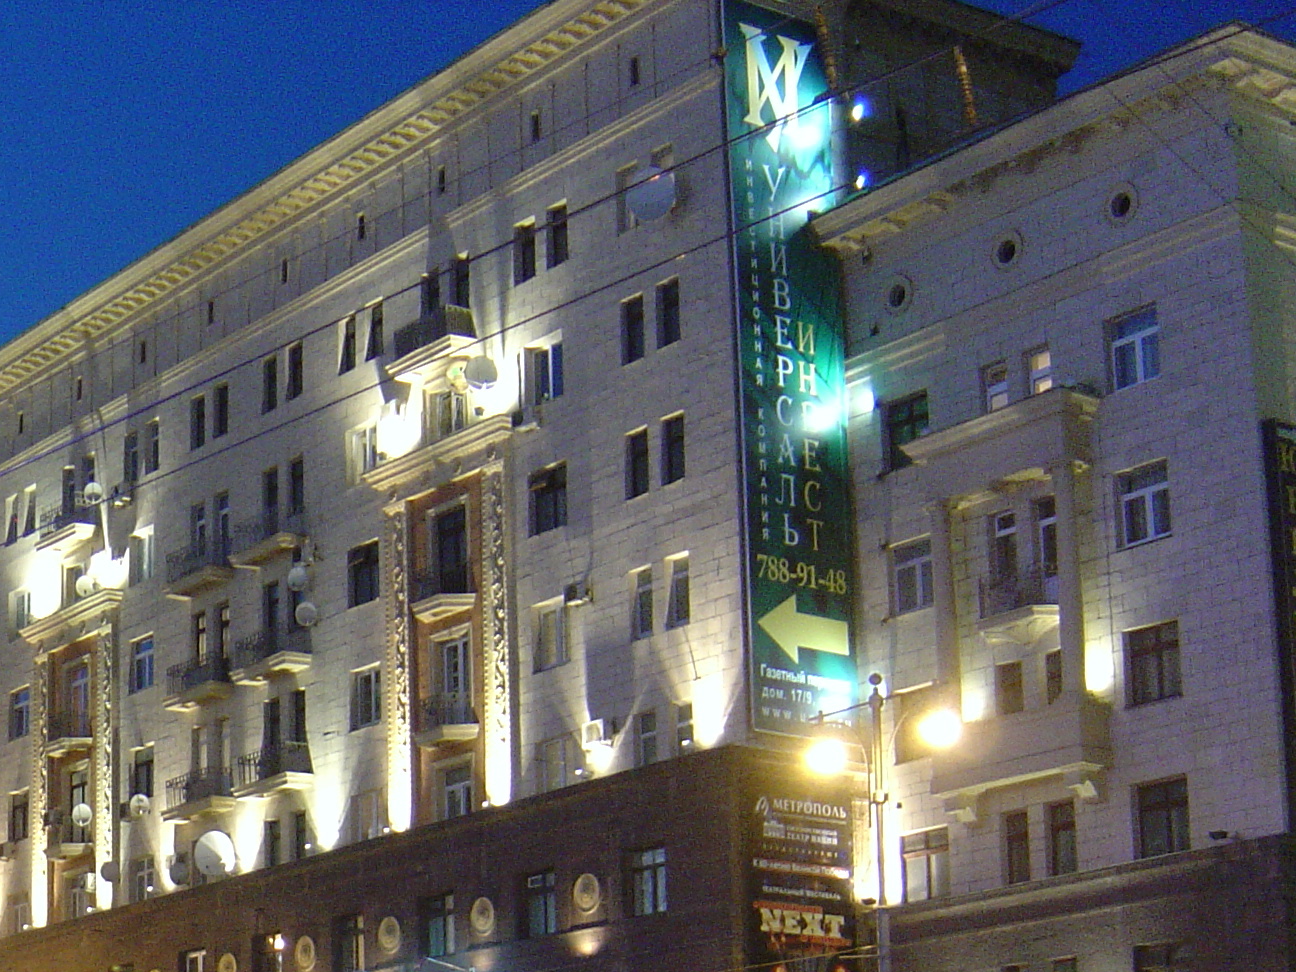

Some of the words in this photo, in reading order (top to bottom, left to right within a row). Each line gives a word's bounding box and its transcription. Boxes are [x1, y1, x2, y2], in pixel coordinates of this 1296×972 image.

[762, 164, 799, 547] УНИВЕРСАЛЬ
[758, 407, 770, 541] КОМПАНИЯ
[757, 554, 847, 595] 788-91-48
[760, 663, 806, 685] Газетный
[773, 799, 848, 819] МЕТРОПОЛЬ
[760, 907, 846, 938] NEXT
